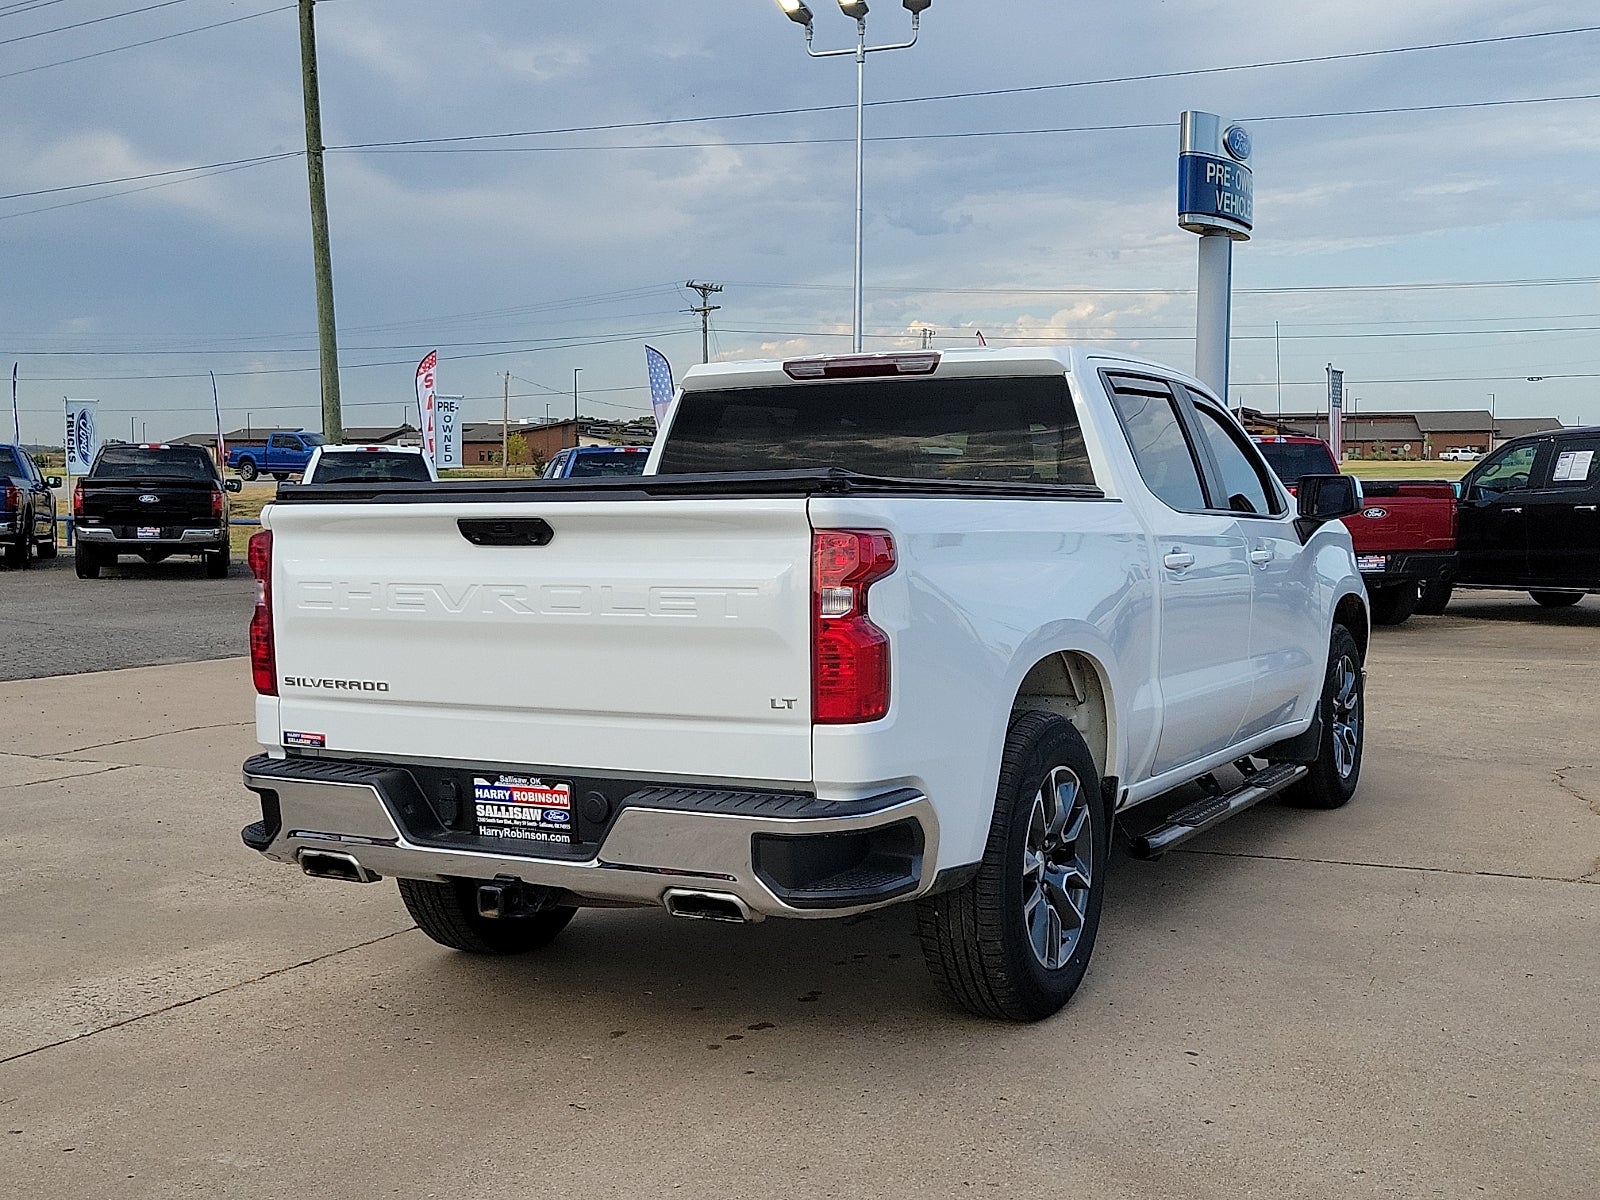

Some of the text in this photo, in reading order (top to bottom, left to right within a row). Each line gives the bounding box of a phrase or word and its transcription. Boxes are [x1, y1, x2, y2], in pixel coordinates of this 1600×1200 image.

[437, 401, 459, 412] PRE-
[67, 412, 76, 463] TRUCKS
[441, 415, 454, 462] OWNED
[298, 581, 759, 618] CHEVROLET
[284, 676, 389, 692] SILVERADO
[770, 698, 797, 709] LT
[529, 777, 541, 785] OK
[475, 788, 567, 804] HARRY ROBINSON
[477, 805, 542, 820] SALLISAW
[479, 826, 570, 843] HarryRobinson.com
